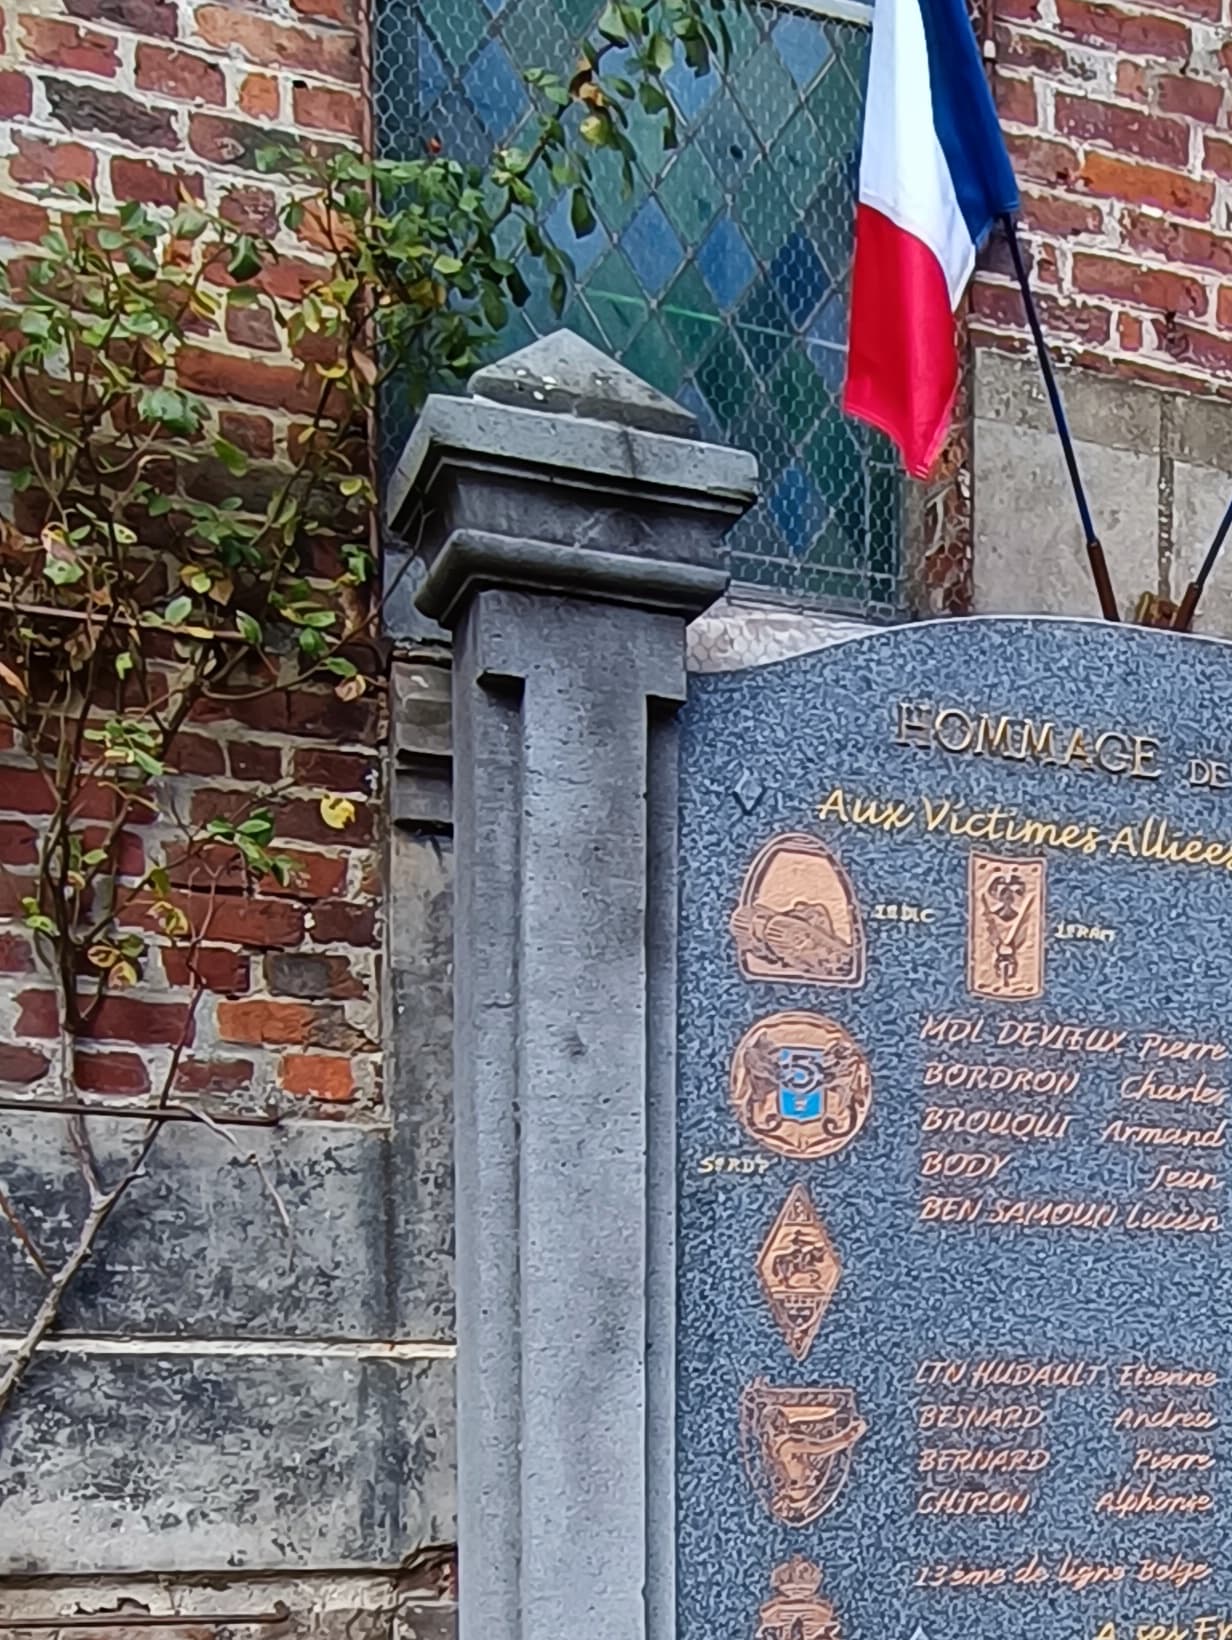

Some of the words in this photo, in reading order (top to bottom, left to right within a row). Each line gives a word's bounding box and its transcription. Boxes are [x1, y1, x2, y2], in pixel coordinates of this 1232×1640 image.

[896, 700, 1161, 779] HOMMAGE
[1189, 758, 1231, 790] DE
[817, 788, 916, 831] Aux
[921, 796, 1106, 855] Victimes
[920, 1016, 984, 1041] MDL
[1138, 1032, 1229, 1060] Pierre
[923, 1061, 1080, 1094] BORDRON
[1120, 1071, 1228, 1105] Charles
[1101, 1119, 1227, 1148] Armand
[920, 1152, 1010, 1178] BODY
[1145, 1164, 1224, 1191] Jean
[920, 1197, 982, 1221] BEN
[1125, 1203, 1223, 1232] Lucien
[971, 1361, 1106, 1387] HUDAULT
[919, 1405, 1045, 1429] BESNARD
[919, 1450, 1050, 1472] BERNARD
[1133, 1449, 1217, 1470] Pierre
[1095, 1482, 1214, 1518] Alphonse
[1013, 1552, 1049, 1584] de
[1057, 1553, 1125, 1590] ligne
[1137, 1554, 1213, 1588] Belge
